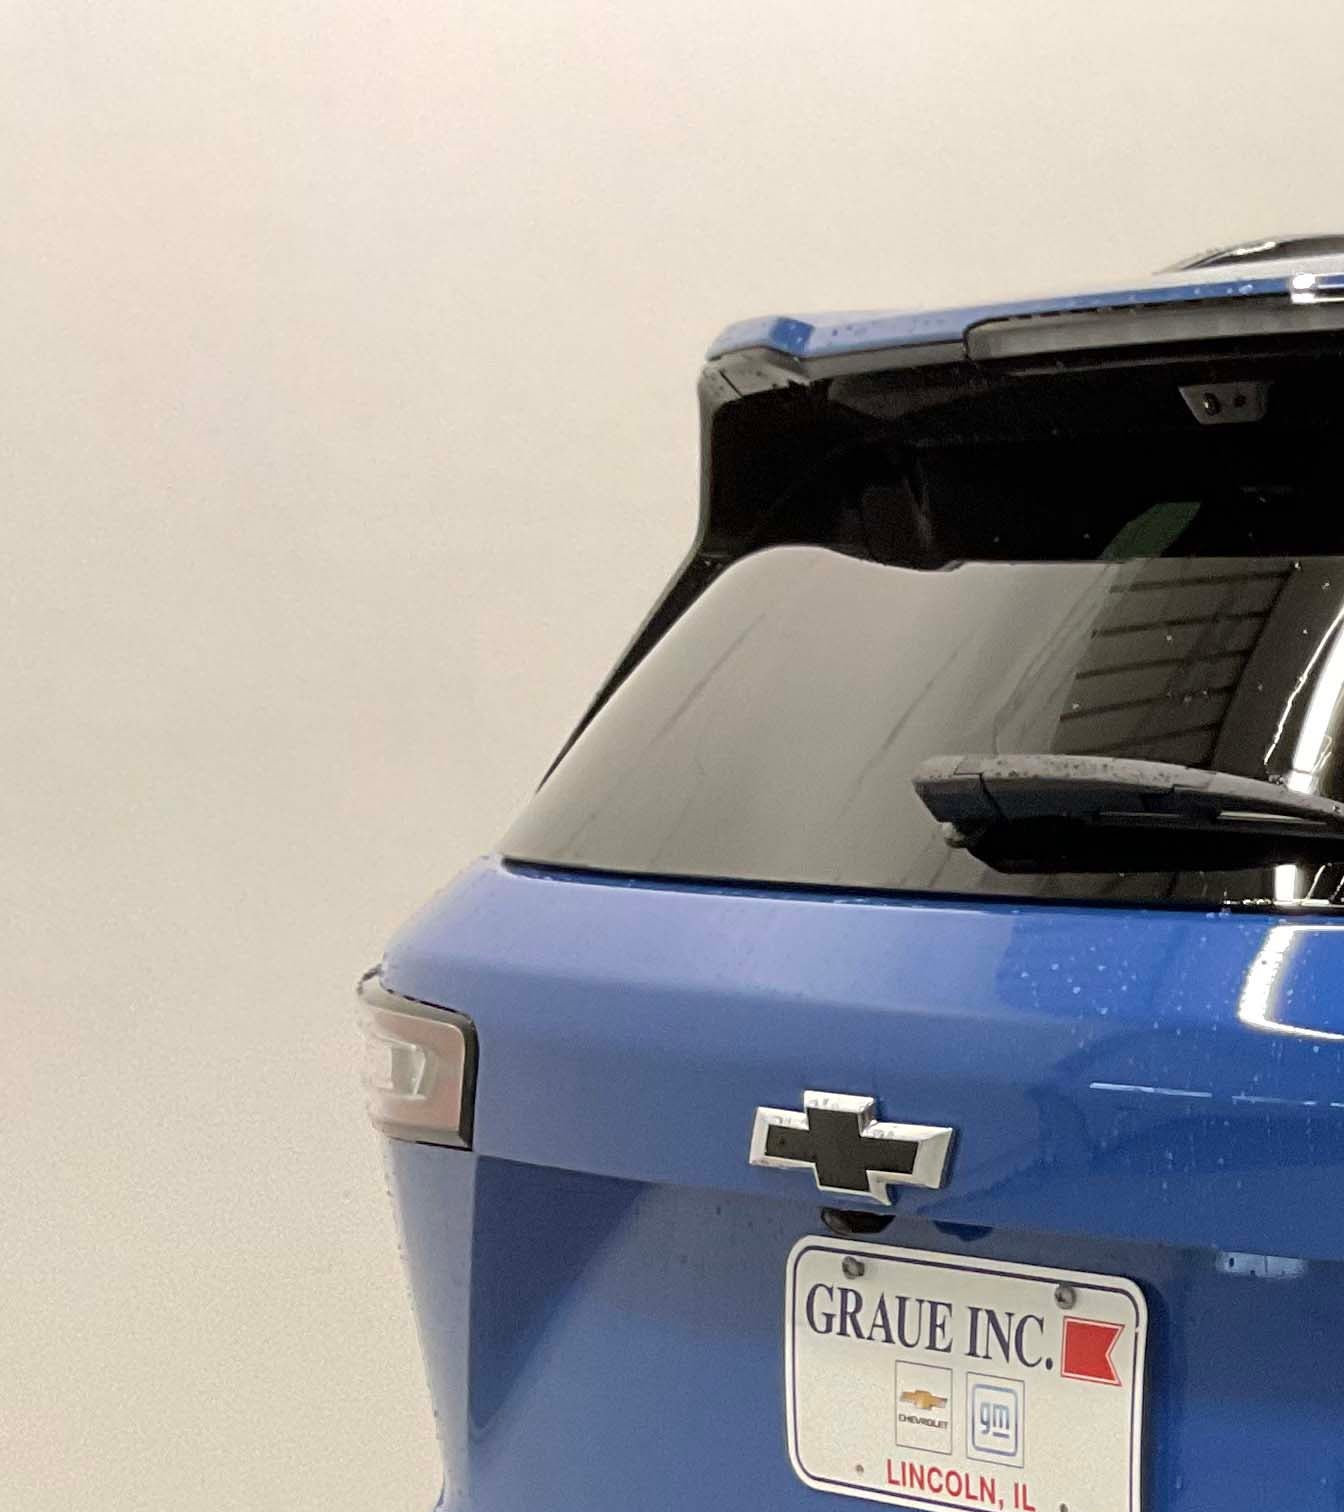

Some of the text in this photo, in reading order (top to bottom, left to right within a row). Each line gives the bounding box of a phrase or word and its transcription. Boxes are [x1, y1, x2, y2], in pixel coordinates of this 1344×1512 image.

[806, 1283, 1055, 1371] GRAUE INC.
[898, 1413, 949, 1430] CHEVROLET
[980, 1402, 1010, 1439] gm
[886, 1458, 1036, 1512] LINCOLN, IL
